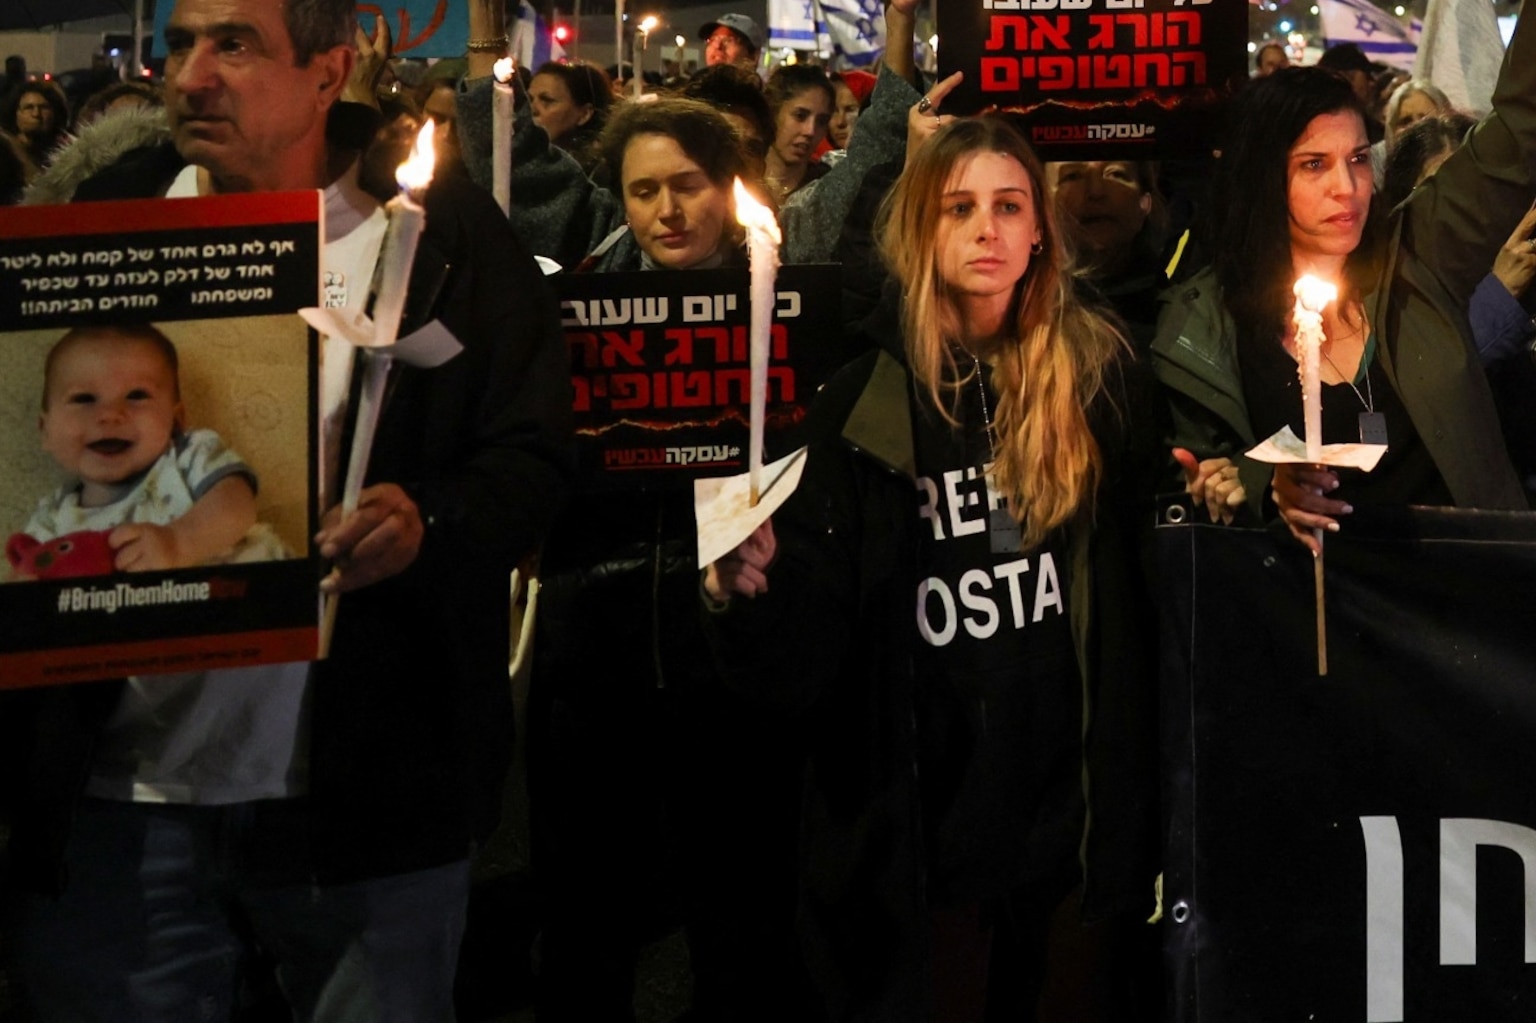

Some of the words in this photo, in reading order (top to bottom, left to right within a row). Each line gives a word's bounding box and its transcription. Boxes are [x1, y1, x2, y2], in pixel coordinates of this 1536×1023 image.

[985, 14, 1072, 51] את
[1088, 11, 1202, 49] הורג
[980, 51, 1207, 92] החטופים
[128, 247, 154, 262] של
[160, 246, 198, 260] אחד
[202, 242, 237, 258] גרם
[241, 240, 266, 255] לא
[269, 239, 295, 257] אף
[0, 253, 42, 270] ליטר
[47, 253, 77, 267] ולא
[82, 249, 123, 267] קמח
[113, 269, 160, 286] לעזה
[163, 267, 199, 287] דלק
[204, 265, 231, 280] של
[236, 264, 275, 278] אחד
[21, 276, 79, 292] שכפיר
[84, 274, 109, 287] עד
[99, 293, 158, 309] חוזרים
[191, 287, 273, 304] ומשפחתו
[21, 297, 94, 316] הביתה!!
[682, 294, 737, 323] יום
[916, 552, 1063, 647] OSTA
